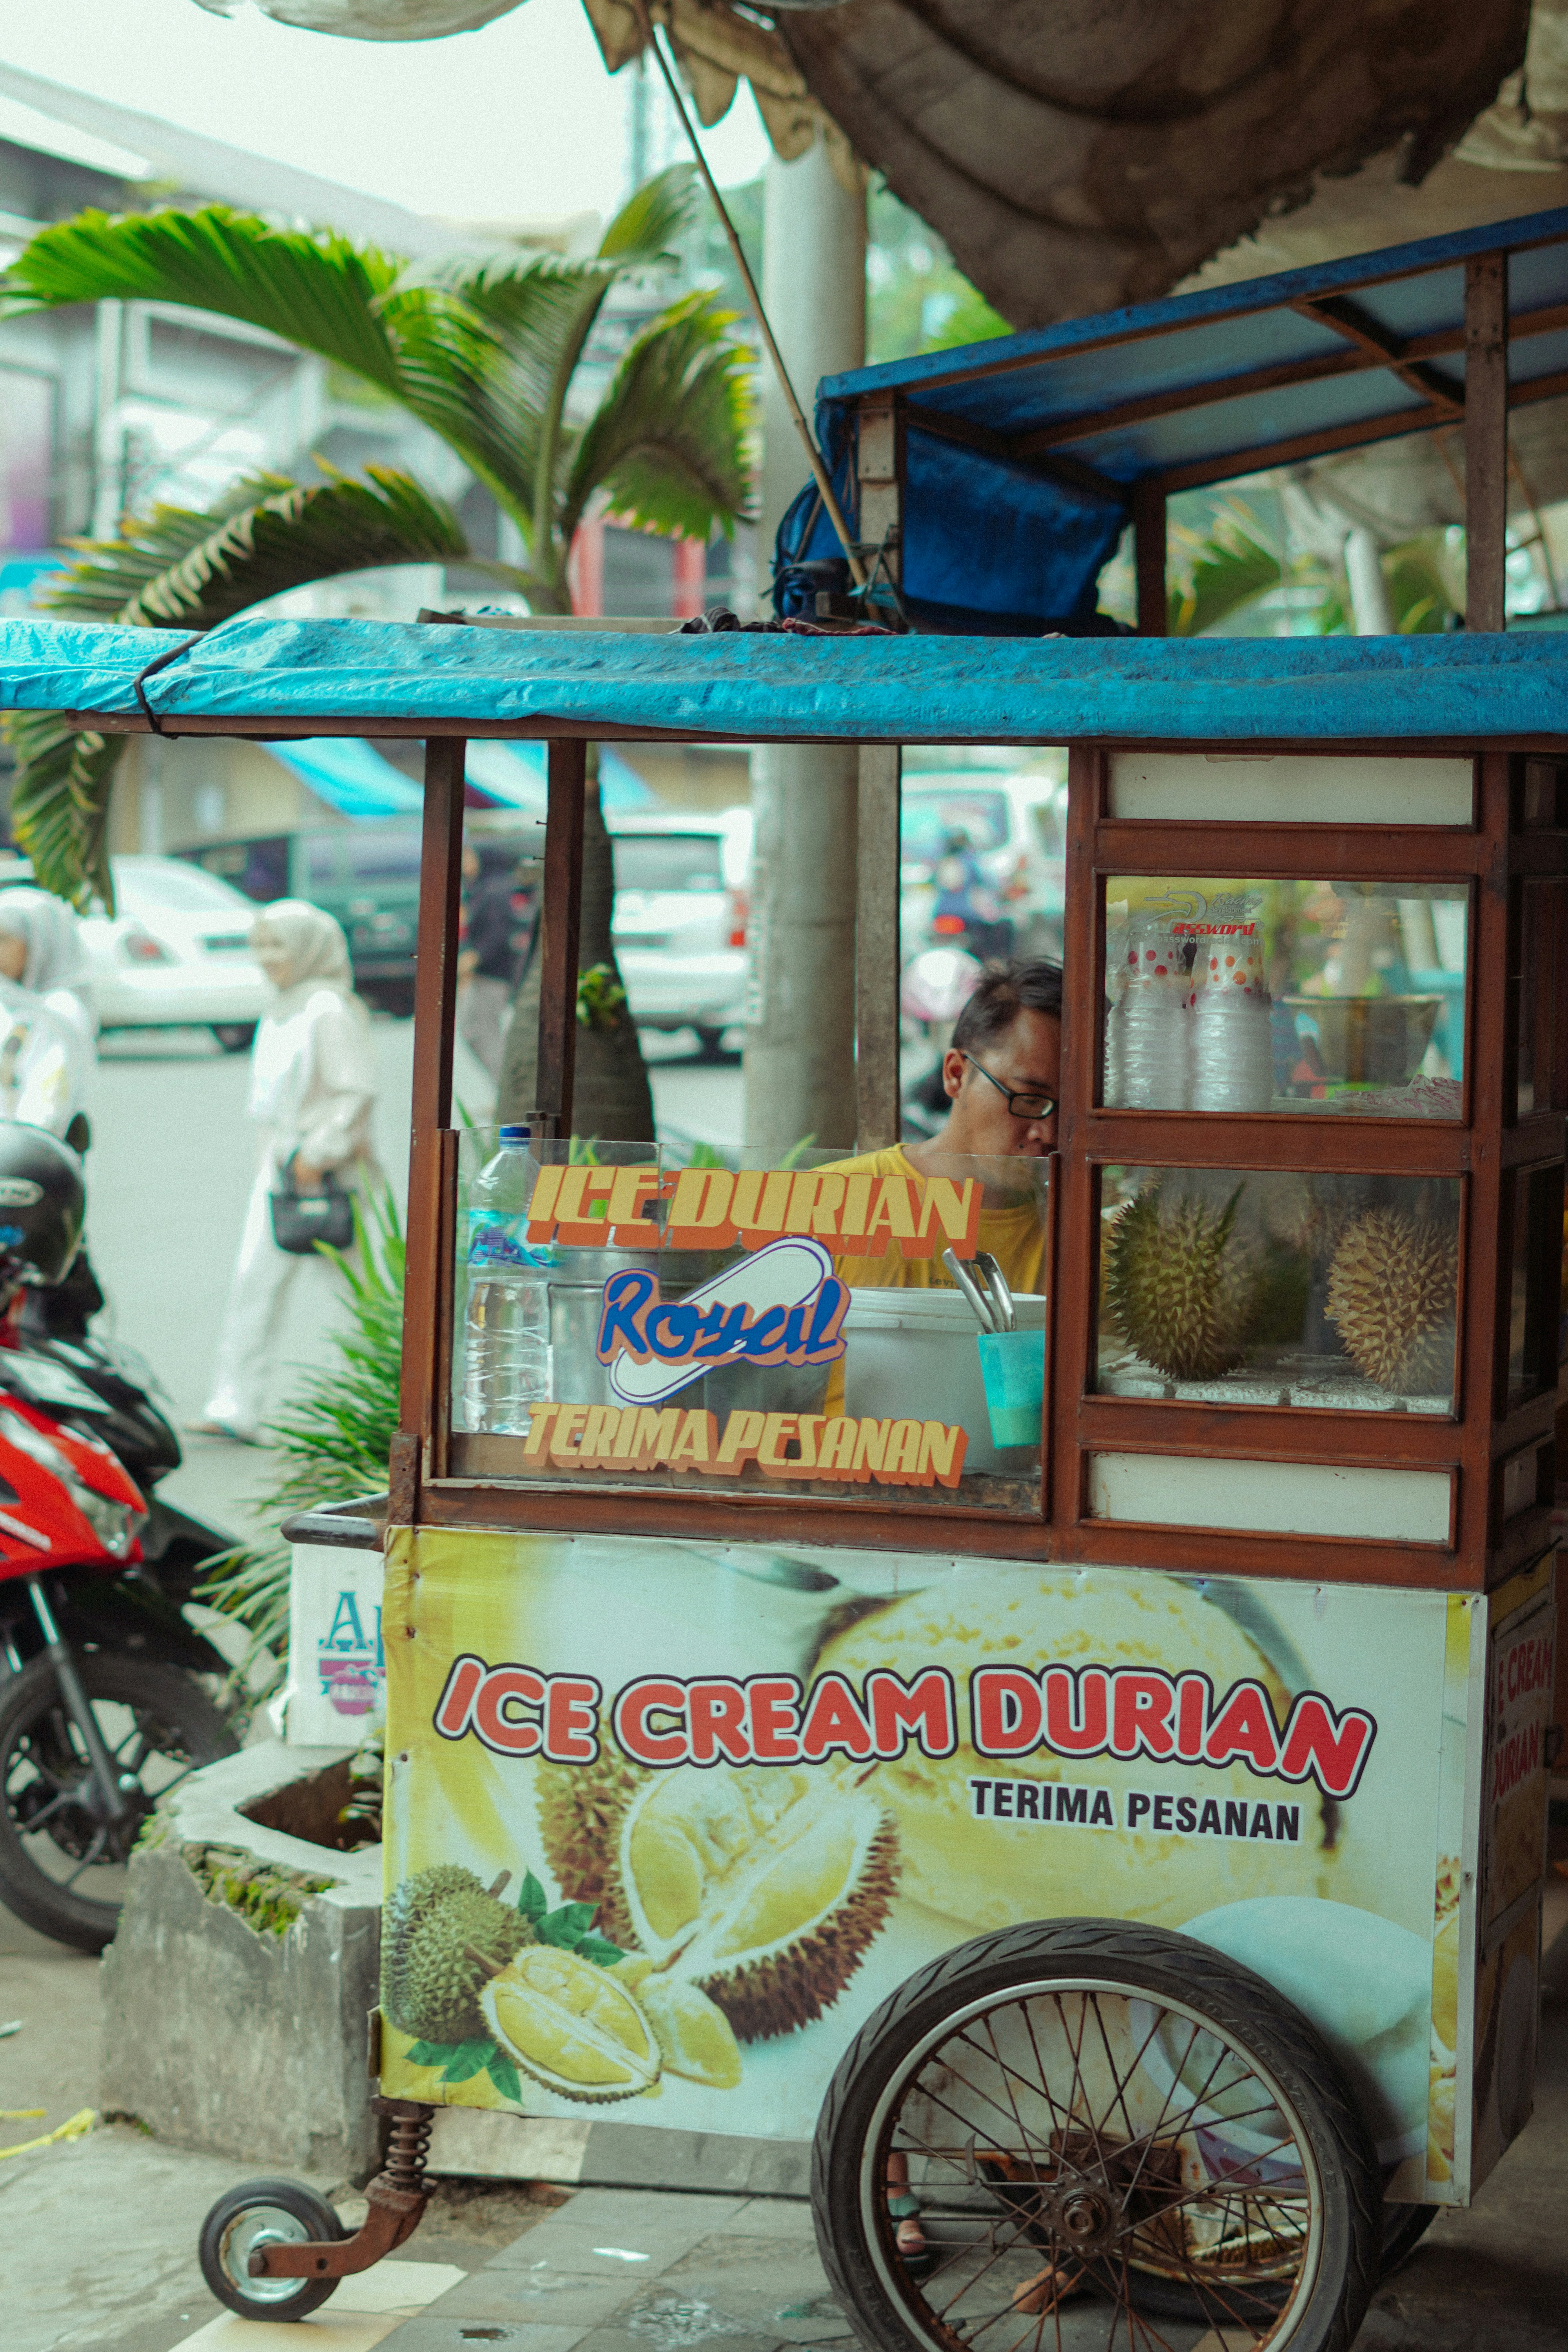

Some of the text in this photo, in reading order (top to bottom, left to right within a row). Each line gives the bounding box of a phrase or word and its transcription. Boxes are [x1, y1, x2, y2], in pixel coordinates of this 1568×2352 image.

[1210, 893, 1263, 909] Racing
[526, 1163, 983, 1260] ICE DURIAN
[597, 1267, 852, 1368] Royal
[523, 1402, 968, 1489] TERIMA PESANAN
[1507, 1639, 1553, 1702] CREAM
[434, 1653, 603, 1766] ICE
[611, 1665, 959, 1769] CREAM
[969, 1663, 1378, 1801] DURIAN
[971, 1780, 1299, 1841] TERIMA PESANAN
